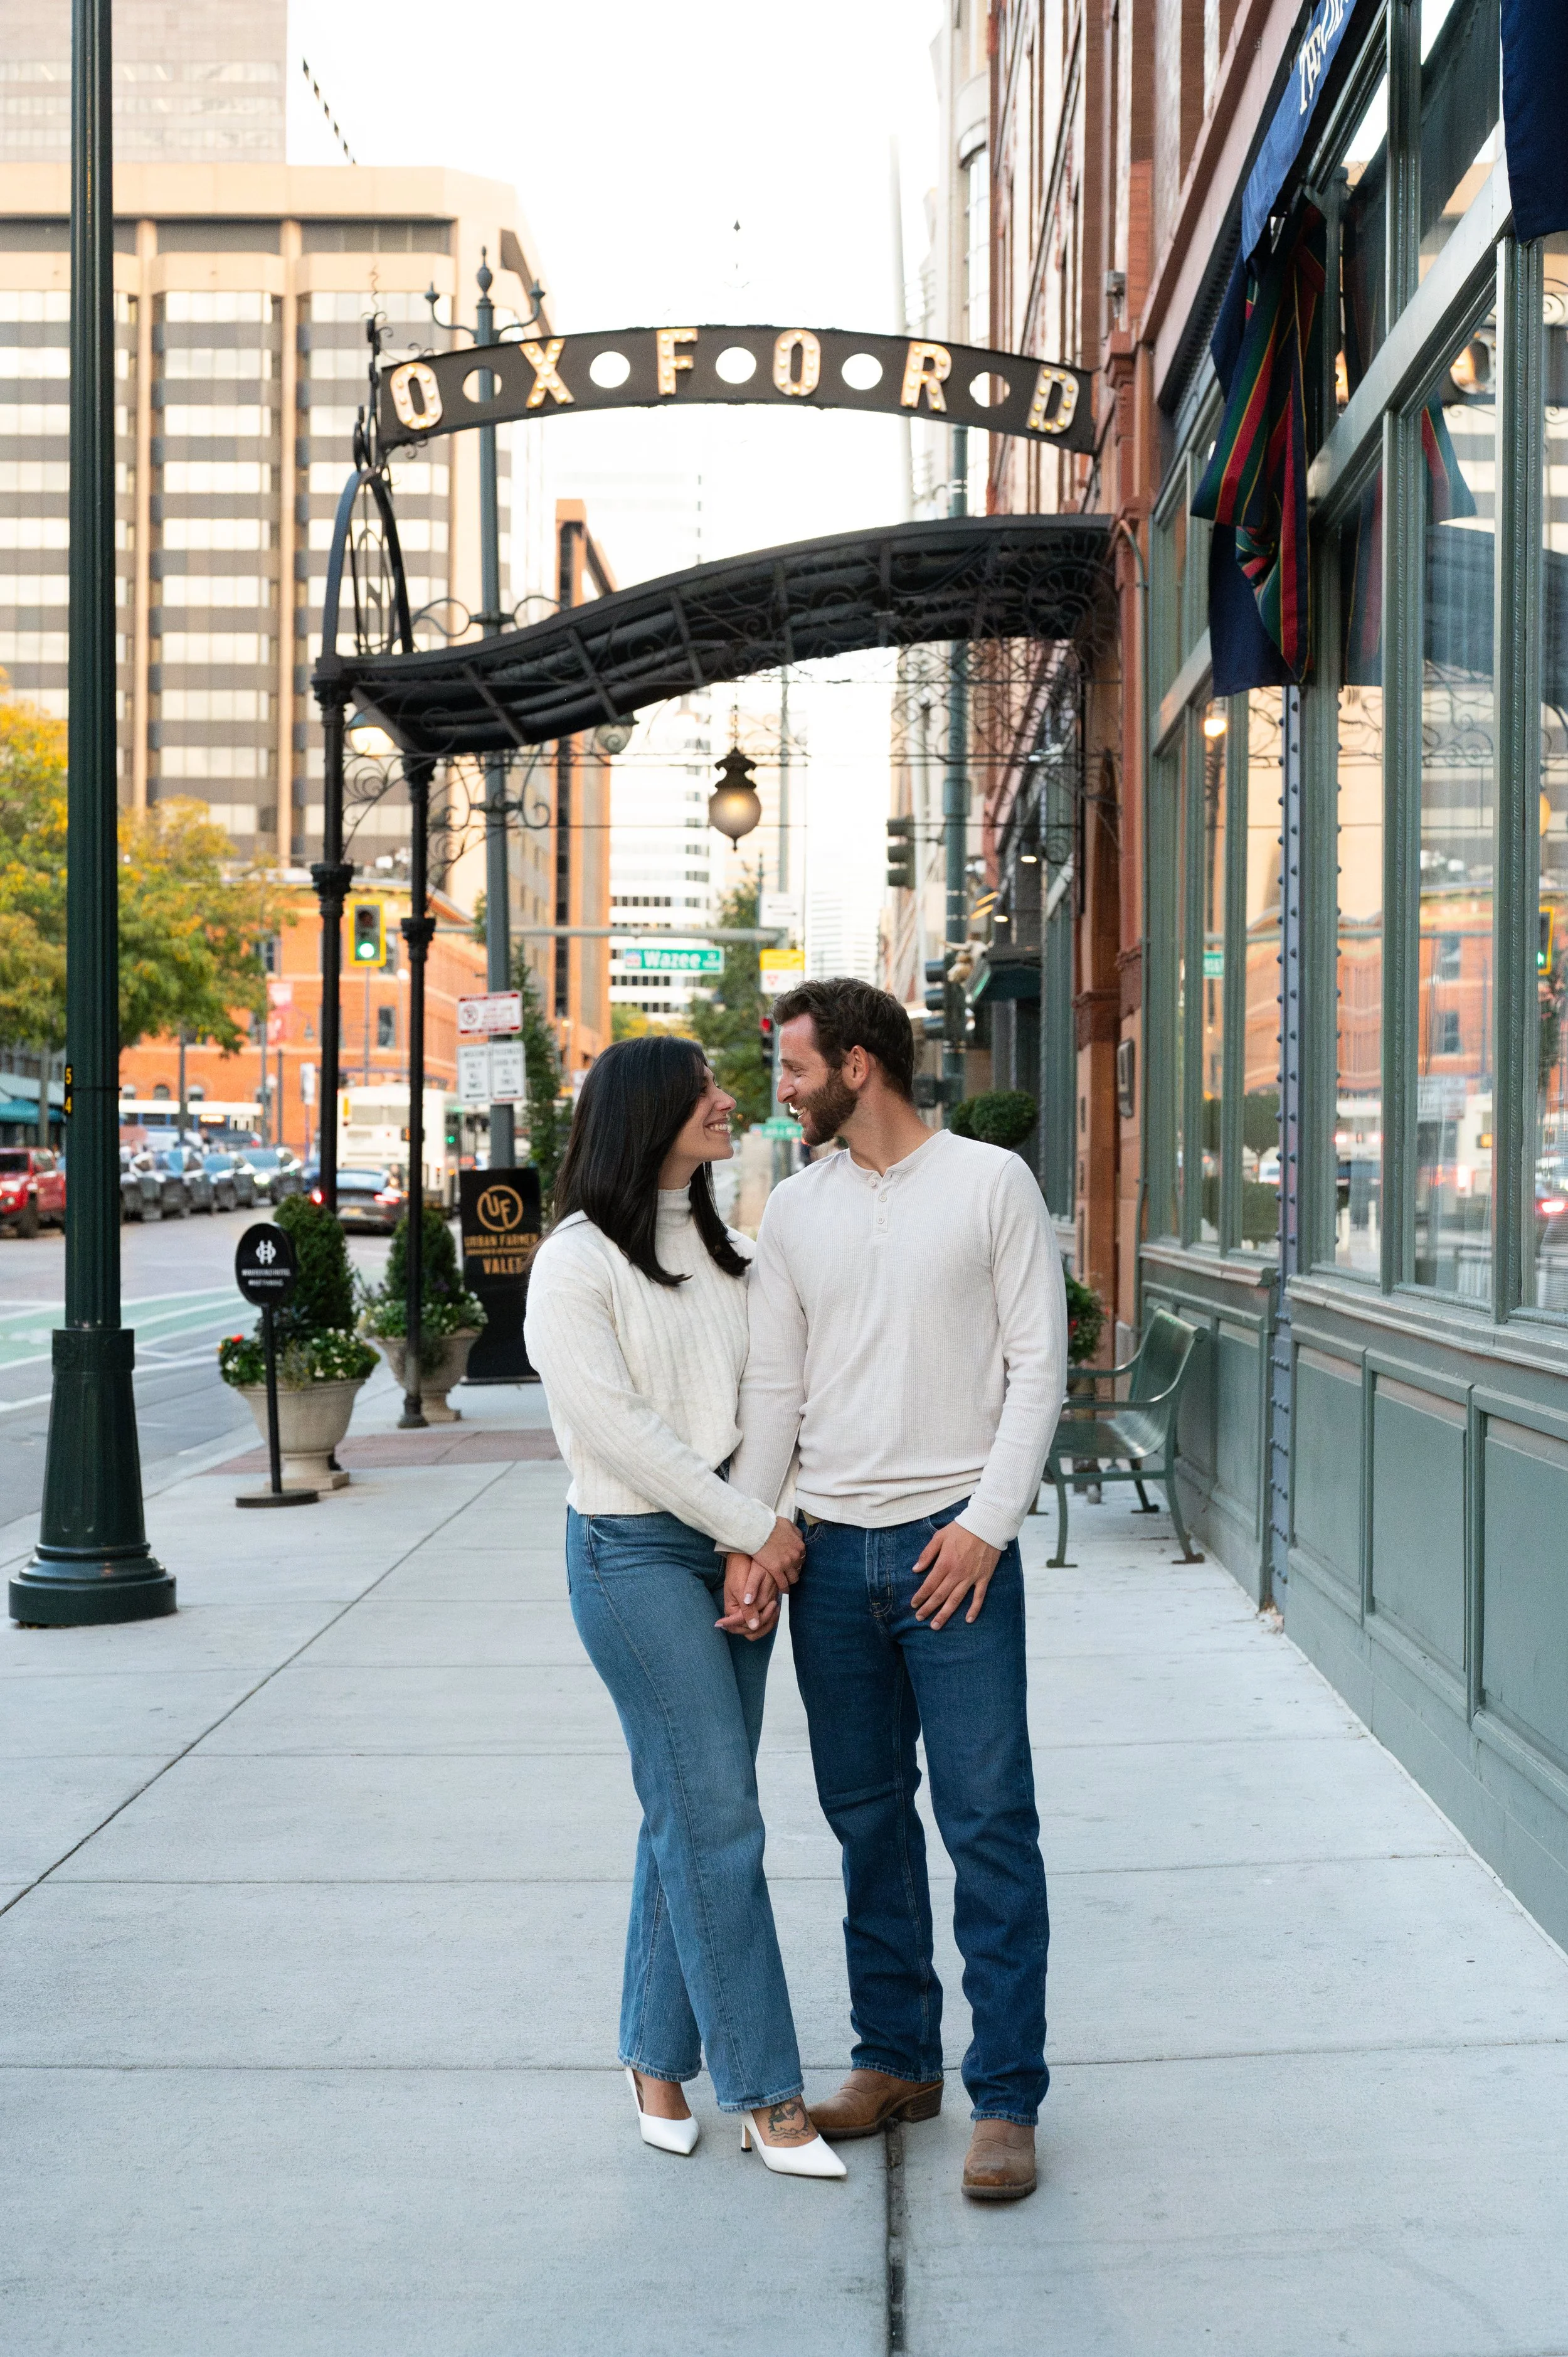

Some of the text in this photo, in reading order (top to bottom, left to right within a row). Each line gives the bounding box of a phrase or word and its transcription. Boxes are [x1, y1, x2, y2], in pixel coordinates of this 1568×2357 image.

[1299, 23, 1321, 115] THE
[389, 327, 1076, 434] OXFORD
[644, 950, 701, 969] Wazee
